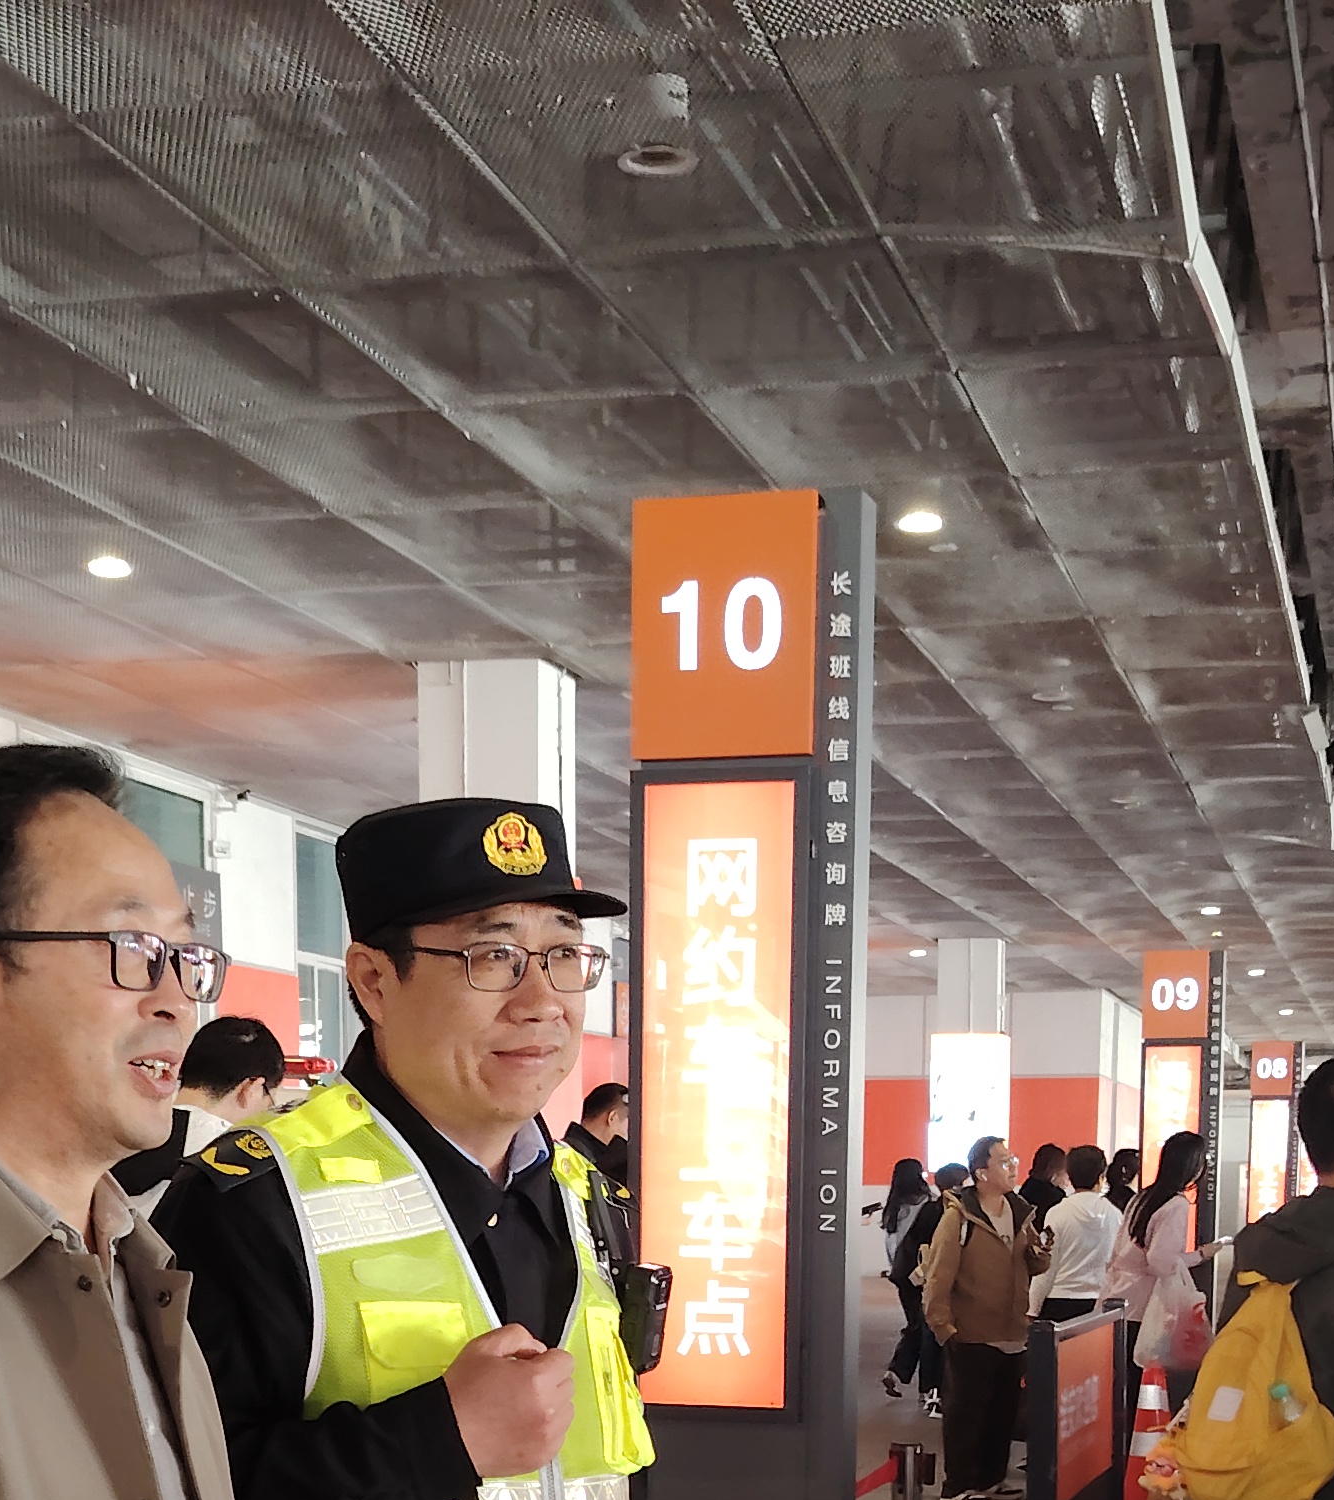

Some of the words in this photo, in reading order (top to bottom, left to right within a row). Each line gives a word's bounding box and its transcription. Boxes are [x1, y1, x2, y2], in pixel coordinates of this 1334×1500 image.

[659, 577, 783, 672] 10
[824, 570, 853, 926] 长途班线信息咨询牌
[1151, 977, 1199, 1011] 09
[821, 958, 843, 1136] INFORMA
[1256, 1057, 1288, 1079] 08
[819, 1168, 838, 1232] ION
